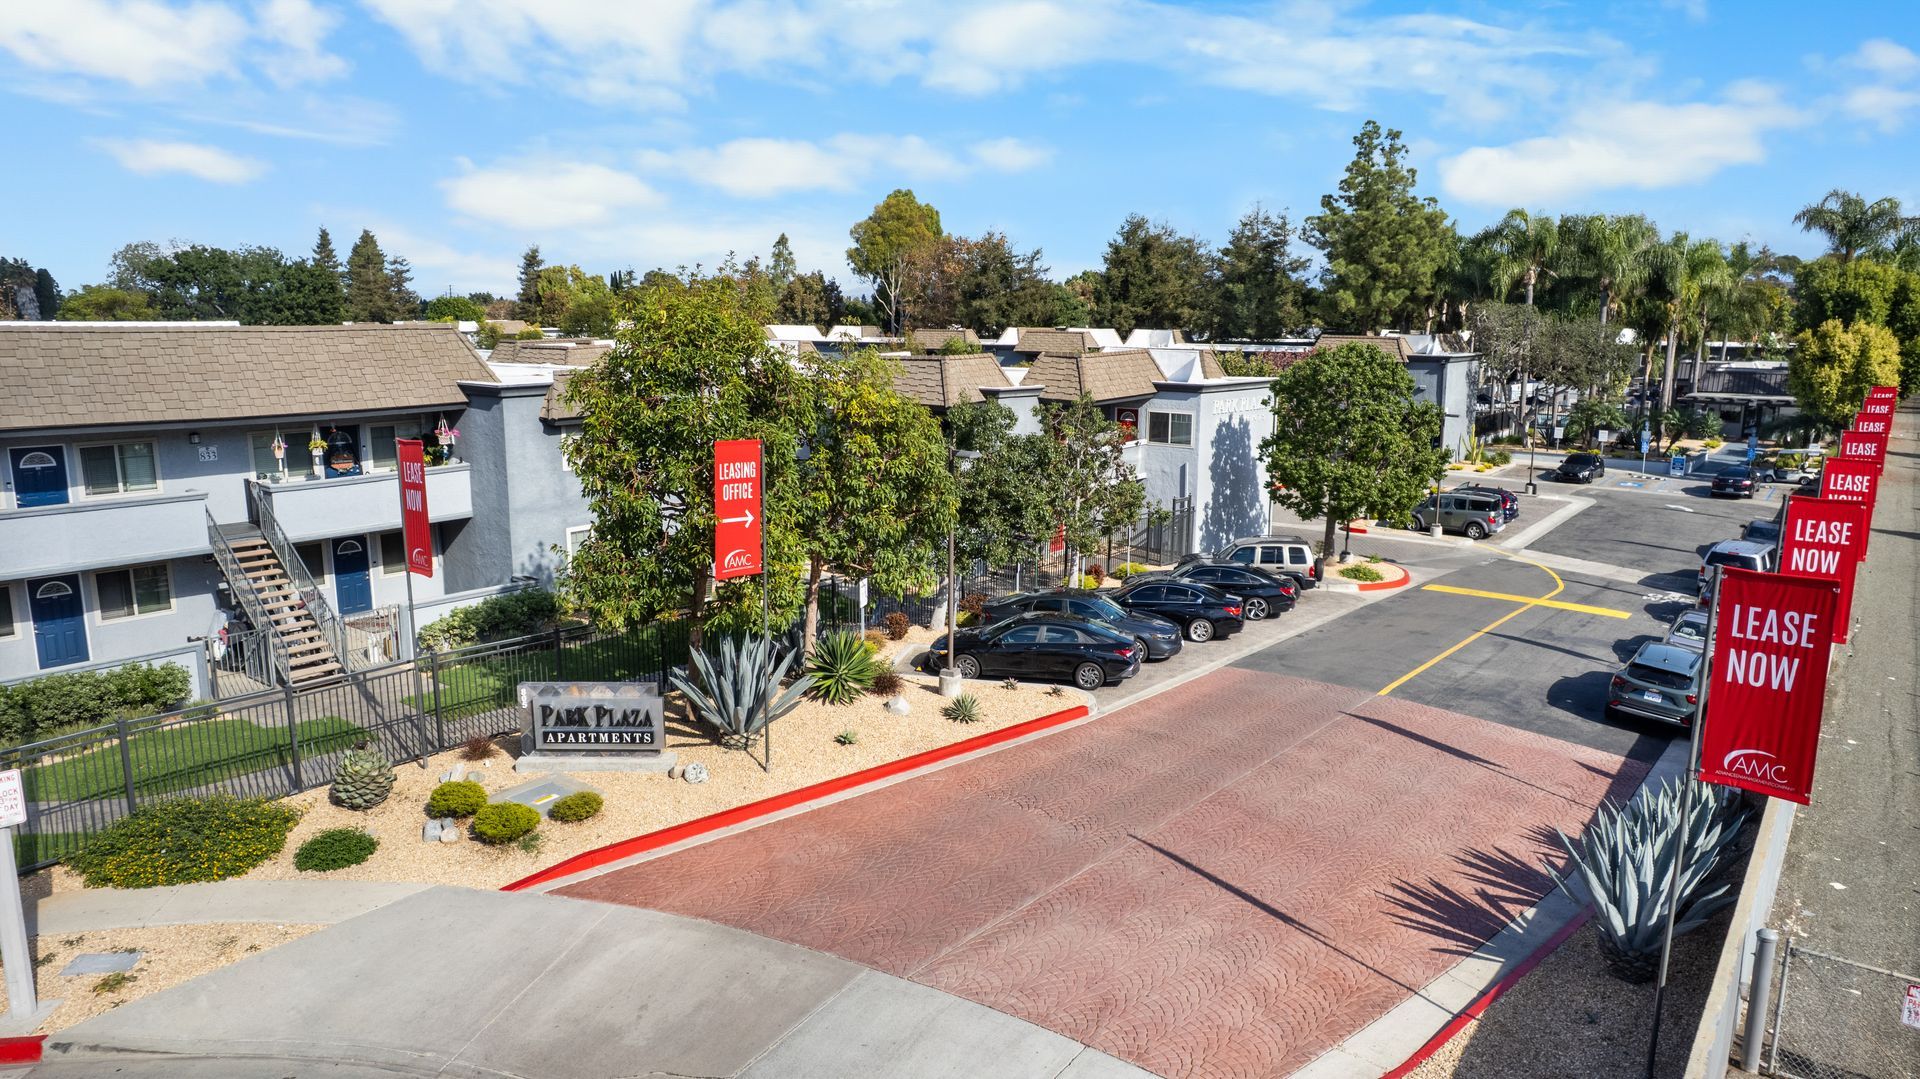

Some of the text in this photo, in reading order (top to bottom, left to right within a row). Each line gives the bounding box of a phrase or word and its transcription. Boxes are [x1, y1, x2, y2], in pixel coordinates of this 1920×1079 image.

[1213, 399, 1238, 414] PARK
[1859, 422, 1885, 432] LEASE
[1846, 443, 1877, 456] LEASE
[403, 461, 423, 484] LEASE
[719, 461, 756, 480] LEASING
[723, 482, 753, 501] OFFICE
[1829, 473, 1870, 492] LEASE
[405, 489, 422, 512] NOW
[1795, 518, 1852, 545] LEASE
[729, 554, 752, 568] AMC
[1791, 547, 1840, 574] NOW
[1731, 604, 1818, 648] LEASE
[1726, 648, 1800, 692] NOW
[539, 704, 655, 727] PARK PLAZA
[546, 733, 652, 744] APARTMENTS
[1732, 756, 1788, 784] AMC
